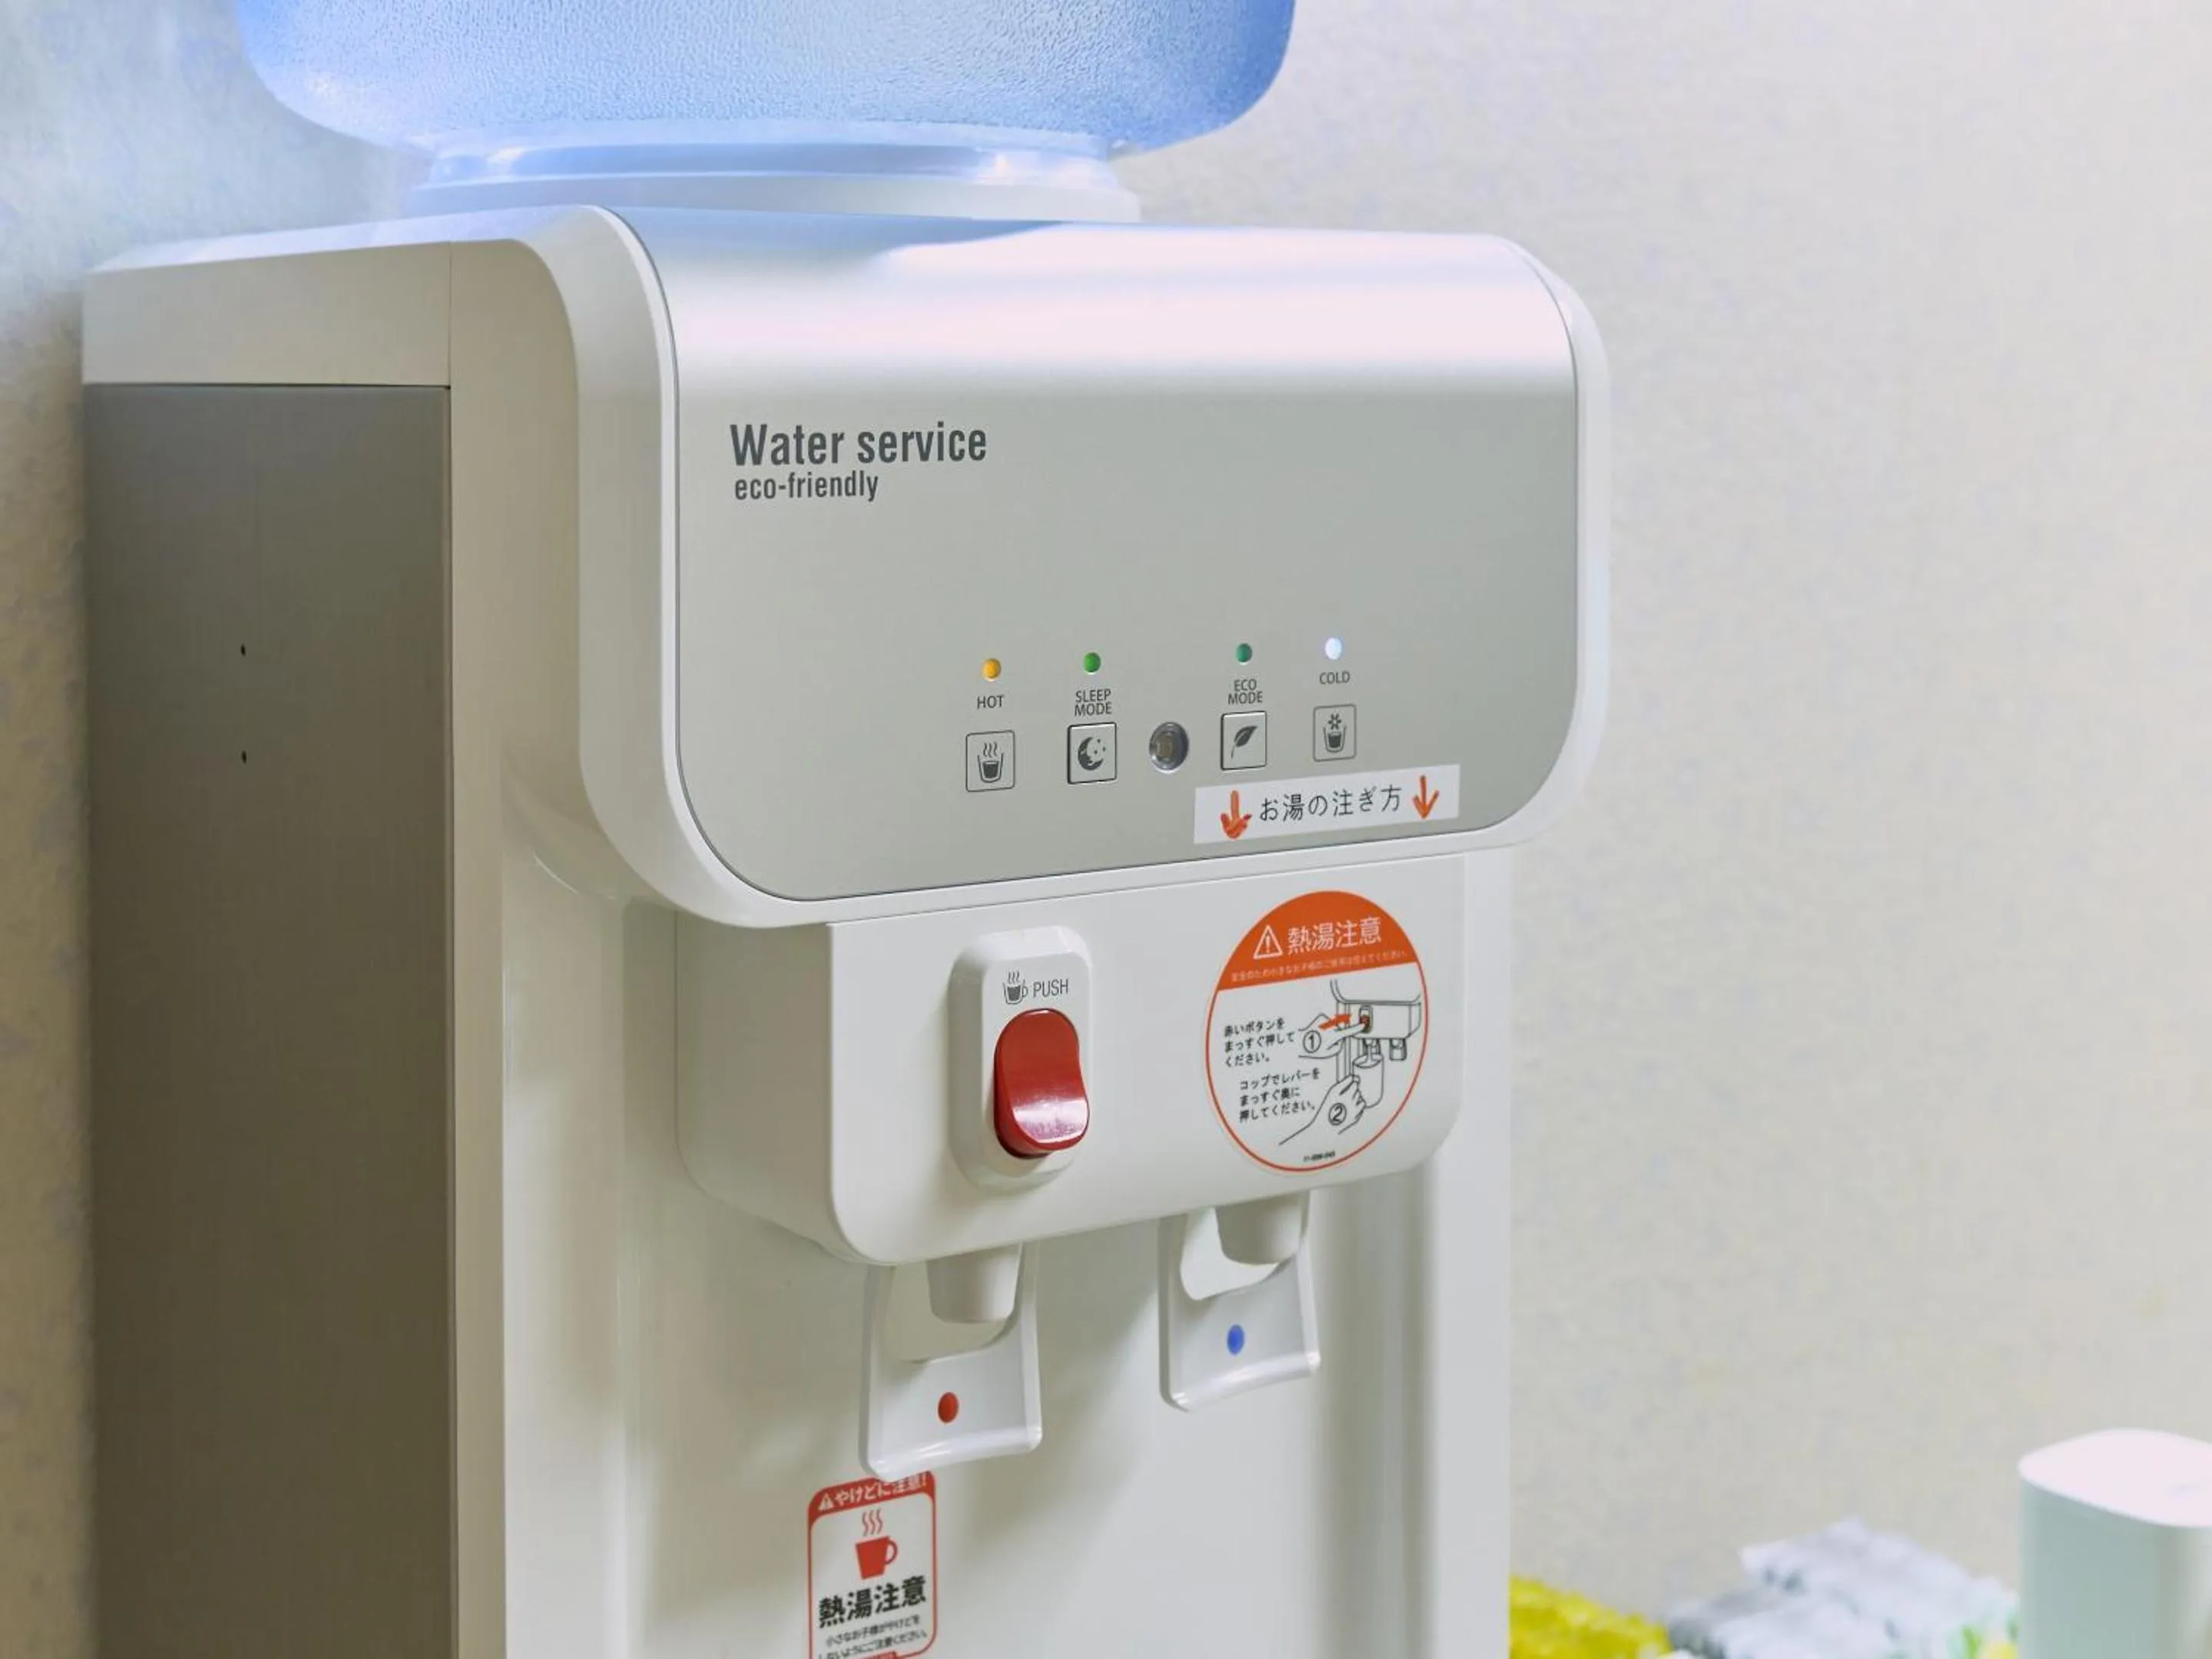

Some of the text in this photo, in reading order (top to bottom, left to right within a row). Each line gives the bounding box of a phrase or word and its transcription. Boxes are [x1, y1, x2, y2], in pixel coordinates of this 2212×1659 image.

[730, 421, 987, 465] Water service
[734, 470, 879, 502] eco-friendly
[1233, 678, 1257, 692] ECO
[1319, 671, 1350, 685] COLD
[977, 694, 1004, 710] HOT
[1075, 688, 1111, 703] SLEEP
[1228, 690, 1263, 705] MODE
[1075, 702, 1112, 717] MODE
[1260, 784, 1402, 822] お湯の注ぎ方
[1286, 916, 1382, 955] 熱湯注意
[1033, 978, 1069, 998] PUSH
[1224, 1017, 1285, 1038] 赤いボタンを
[1224, 1031, 1295, 1053] まっすぐ押して
[1240, 1067, 1320, 1090] コップでレバーを
[818, 1575, 927, 1629] 熱湯注意
